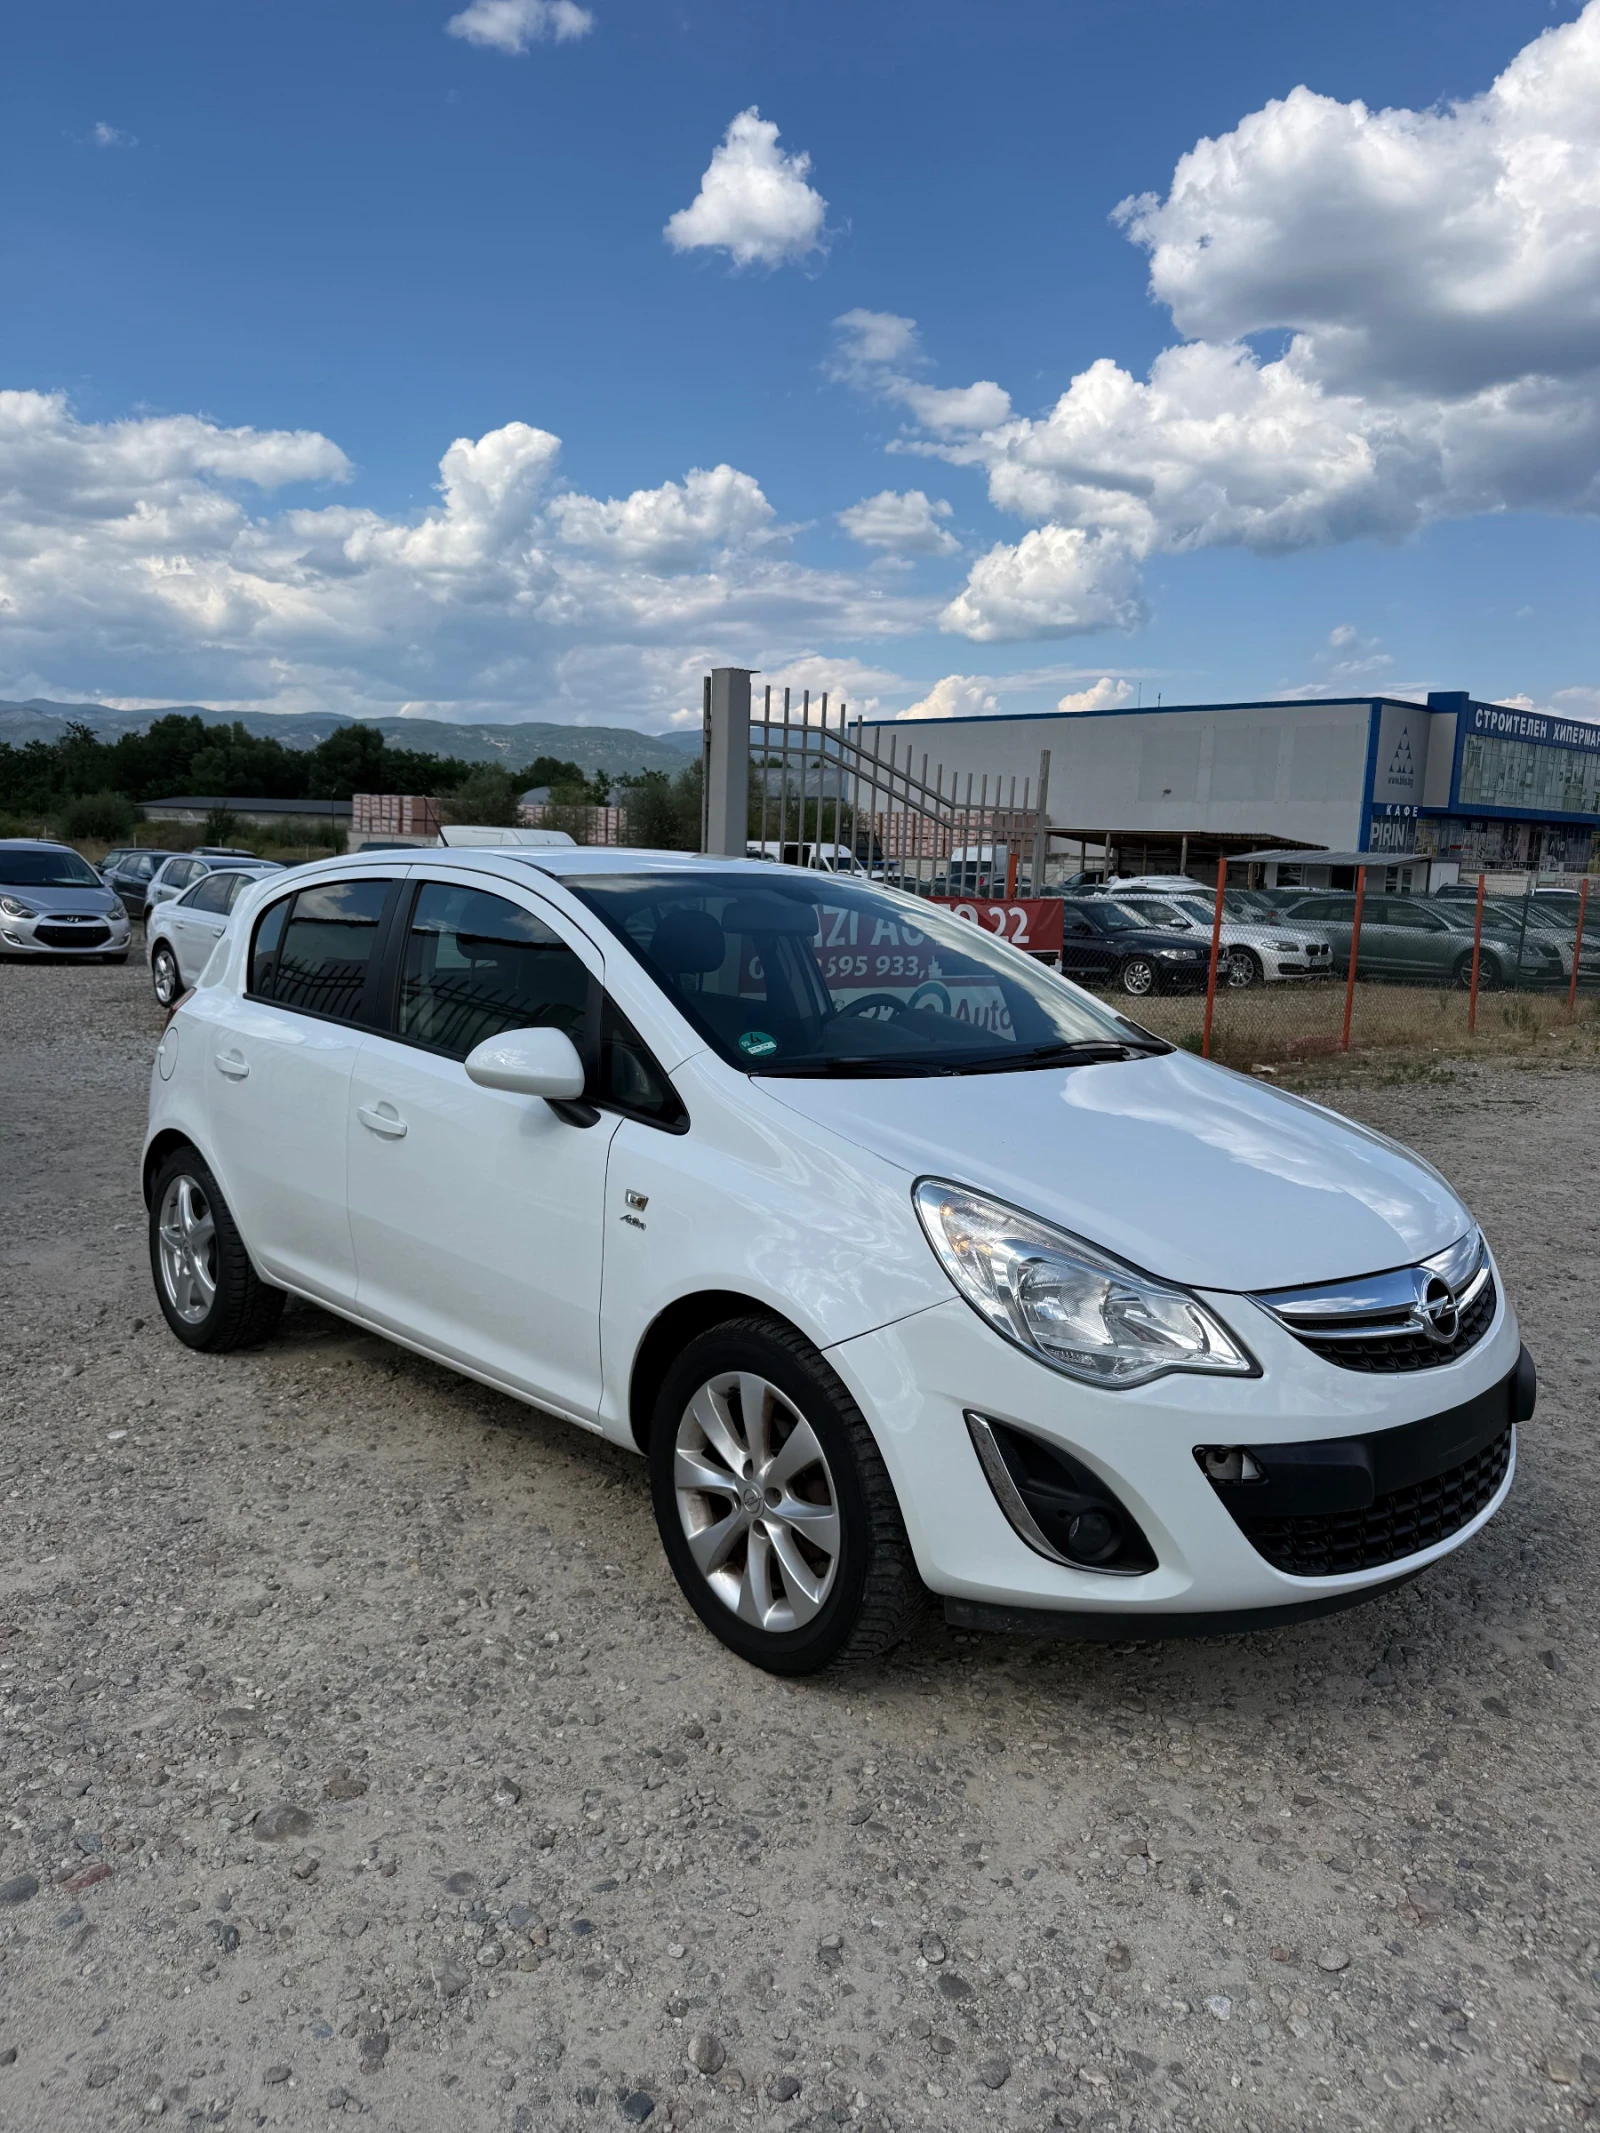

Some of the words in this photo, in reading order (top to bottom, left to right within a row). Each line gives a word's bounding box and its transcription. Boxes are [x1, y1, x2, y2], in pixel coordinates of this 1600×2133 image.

[1475, 709, 1547, 738] СТРОИТЕЛЕН
[1386, 805, 1418, 817] КАФЕ
[1370, 823, 1405, 846] PIRIN
[989, 907, 1029, 943] 22
[956, 999, 1011, 1030] Auto
[750, 1033, 762, 1044] 4
